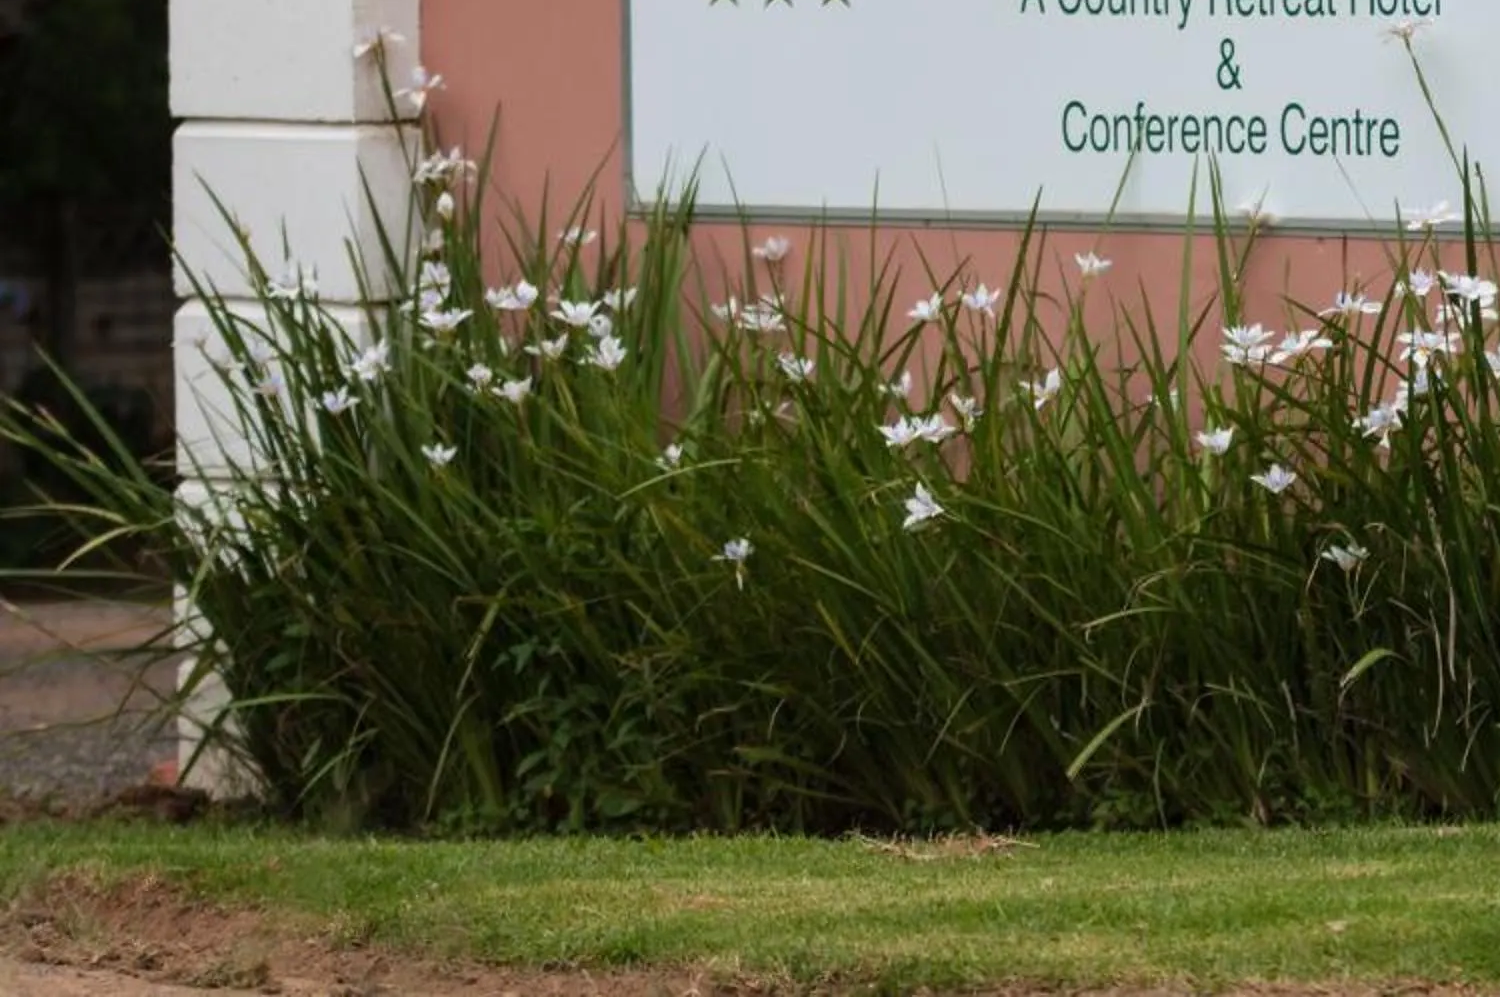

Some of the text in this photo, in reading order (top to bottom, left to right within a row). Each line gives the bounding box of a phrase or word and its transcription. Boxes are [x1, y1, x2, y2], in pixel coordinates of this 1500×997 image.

[1216, 37, 1243, 90] &
[1061, 100, 1400, 157] Conference Centre
